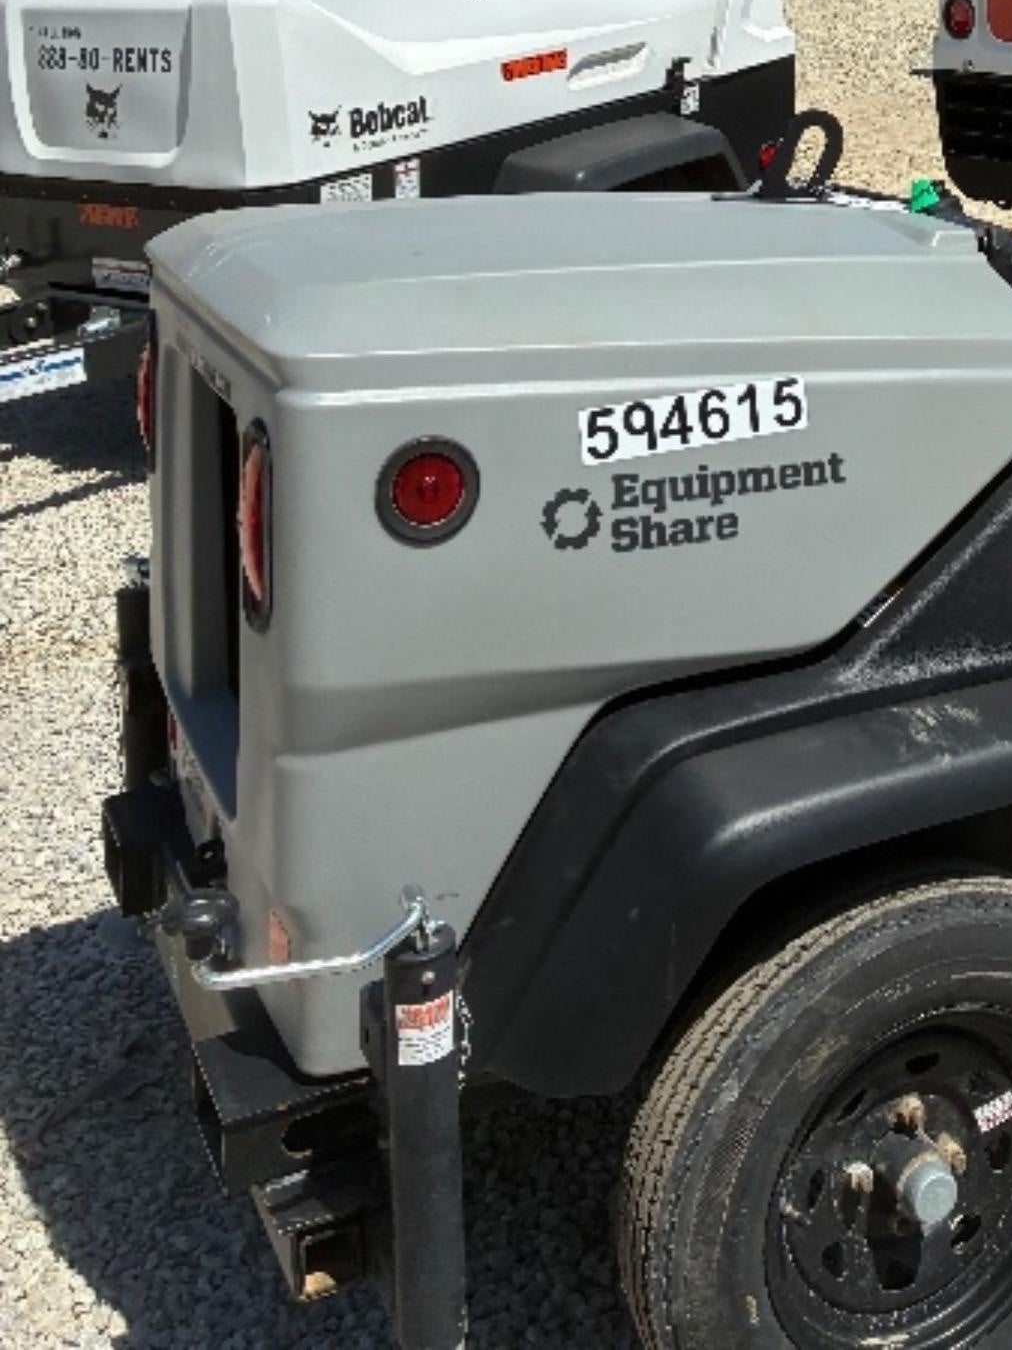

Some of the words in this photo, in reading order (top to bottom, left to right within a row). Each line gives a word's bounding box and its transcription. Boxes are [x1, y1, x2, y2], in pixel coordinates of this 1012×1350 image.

[349, 96, 428, 139] Bobcat
[587, 378, 803, 460] 594615
[611, 453, 847, 514] Equipment
[611, 511, 740, 552] Share
